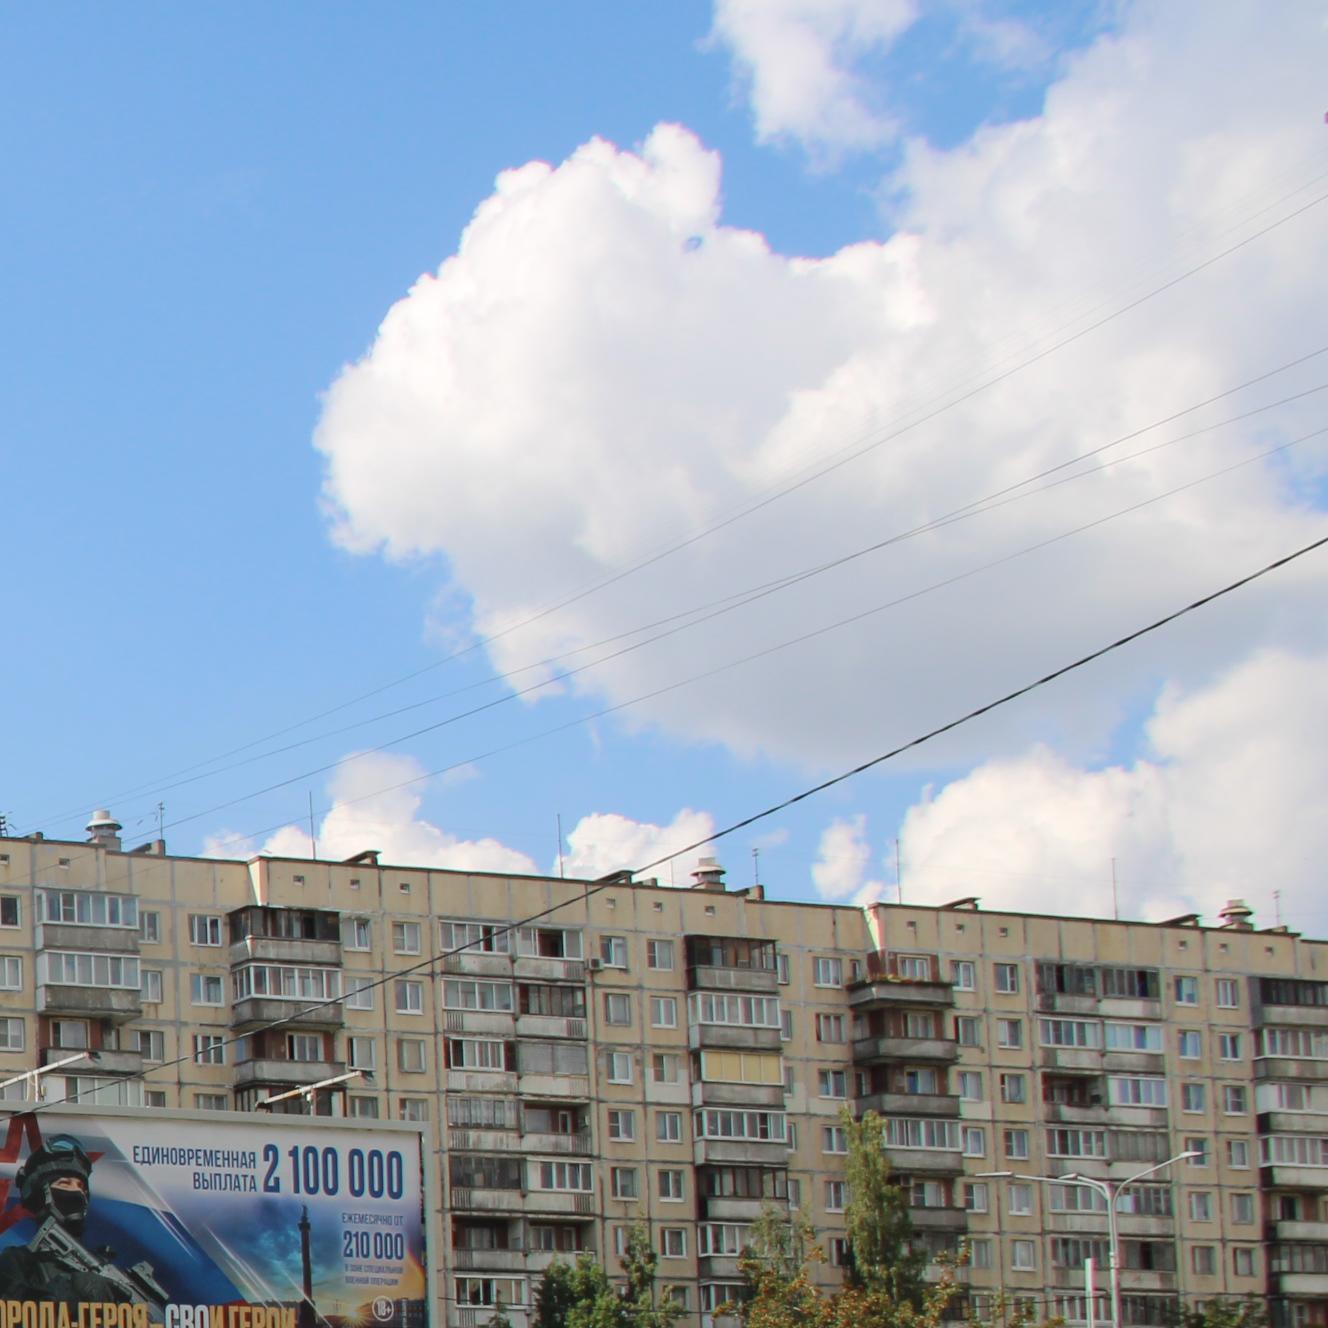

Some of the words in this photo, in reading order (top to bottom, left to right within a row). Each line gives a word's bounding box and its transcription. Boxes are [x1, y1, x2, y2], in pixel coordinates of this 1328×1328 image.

[132, 1145, 257, 1169] ЕДИНОВРЕМЕННАЯ
[262, 1143, 281, 1194] 2
[288, 1145, 339, 1197] 100
[348, 1148, 403, 1200] 000
[193, 1171, 258, 1192] ВЫПЛАТА
[343, 1230, 370, 1258] 210
[373, 1231, 404, 1260] 000
